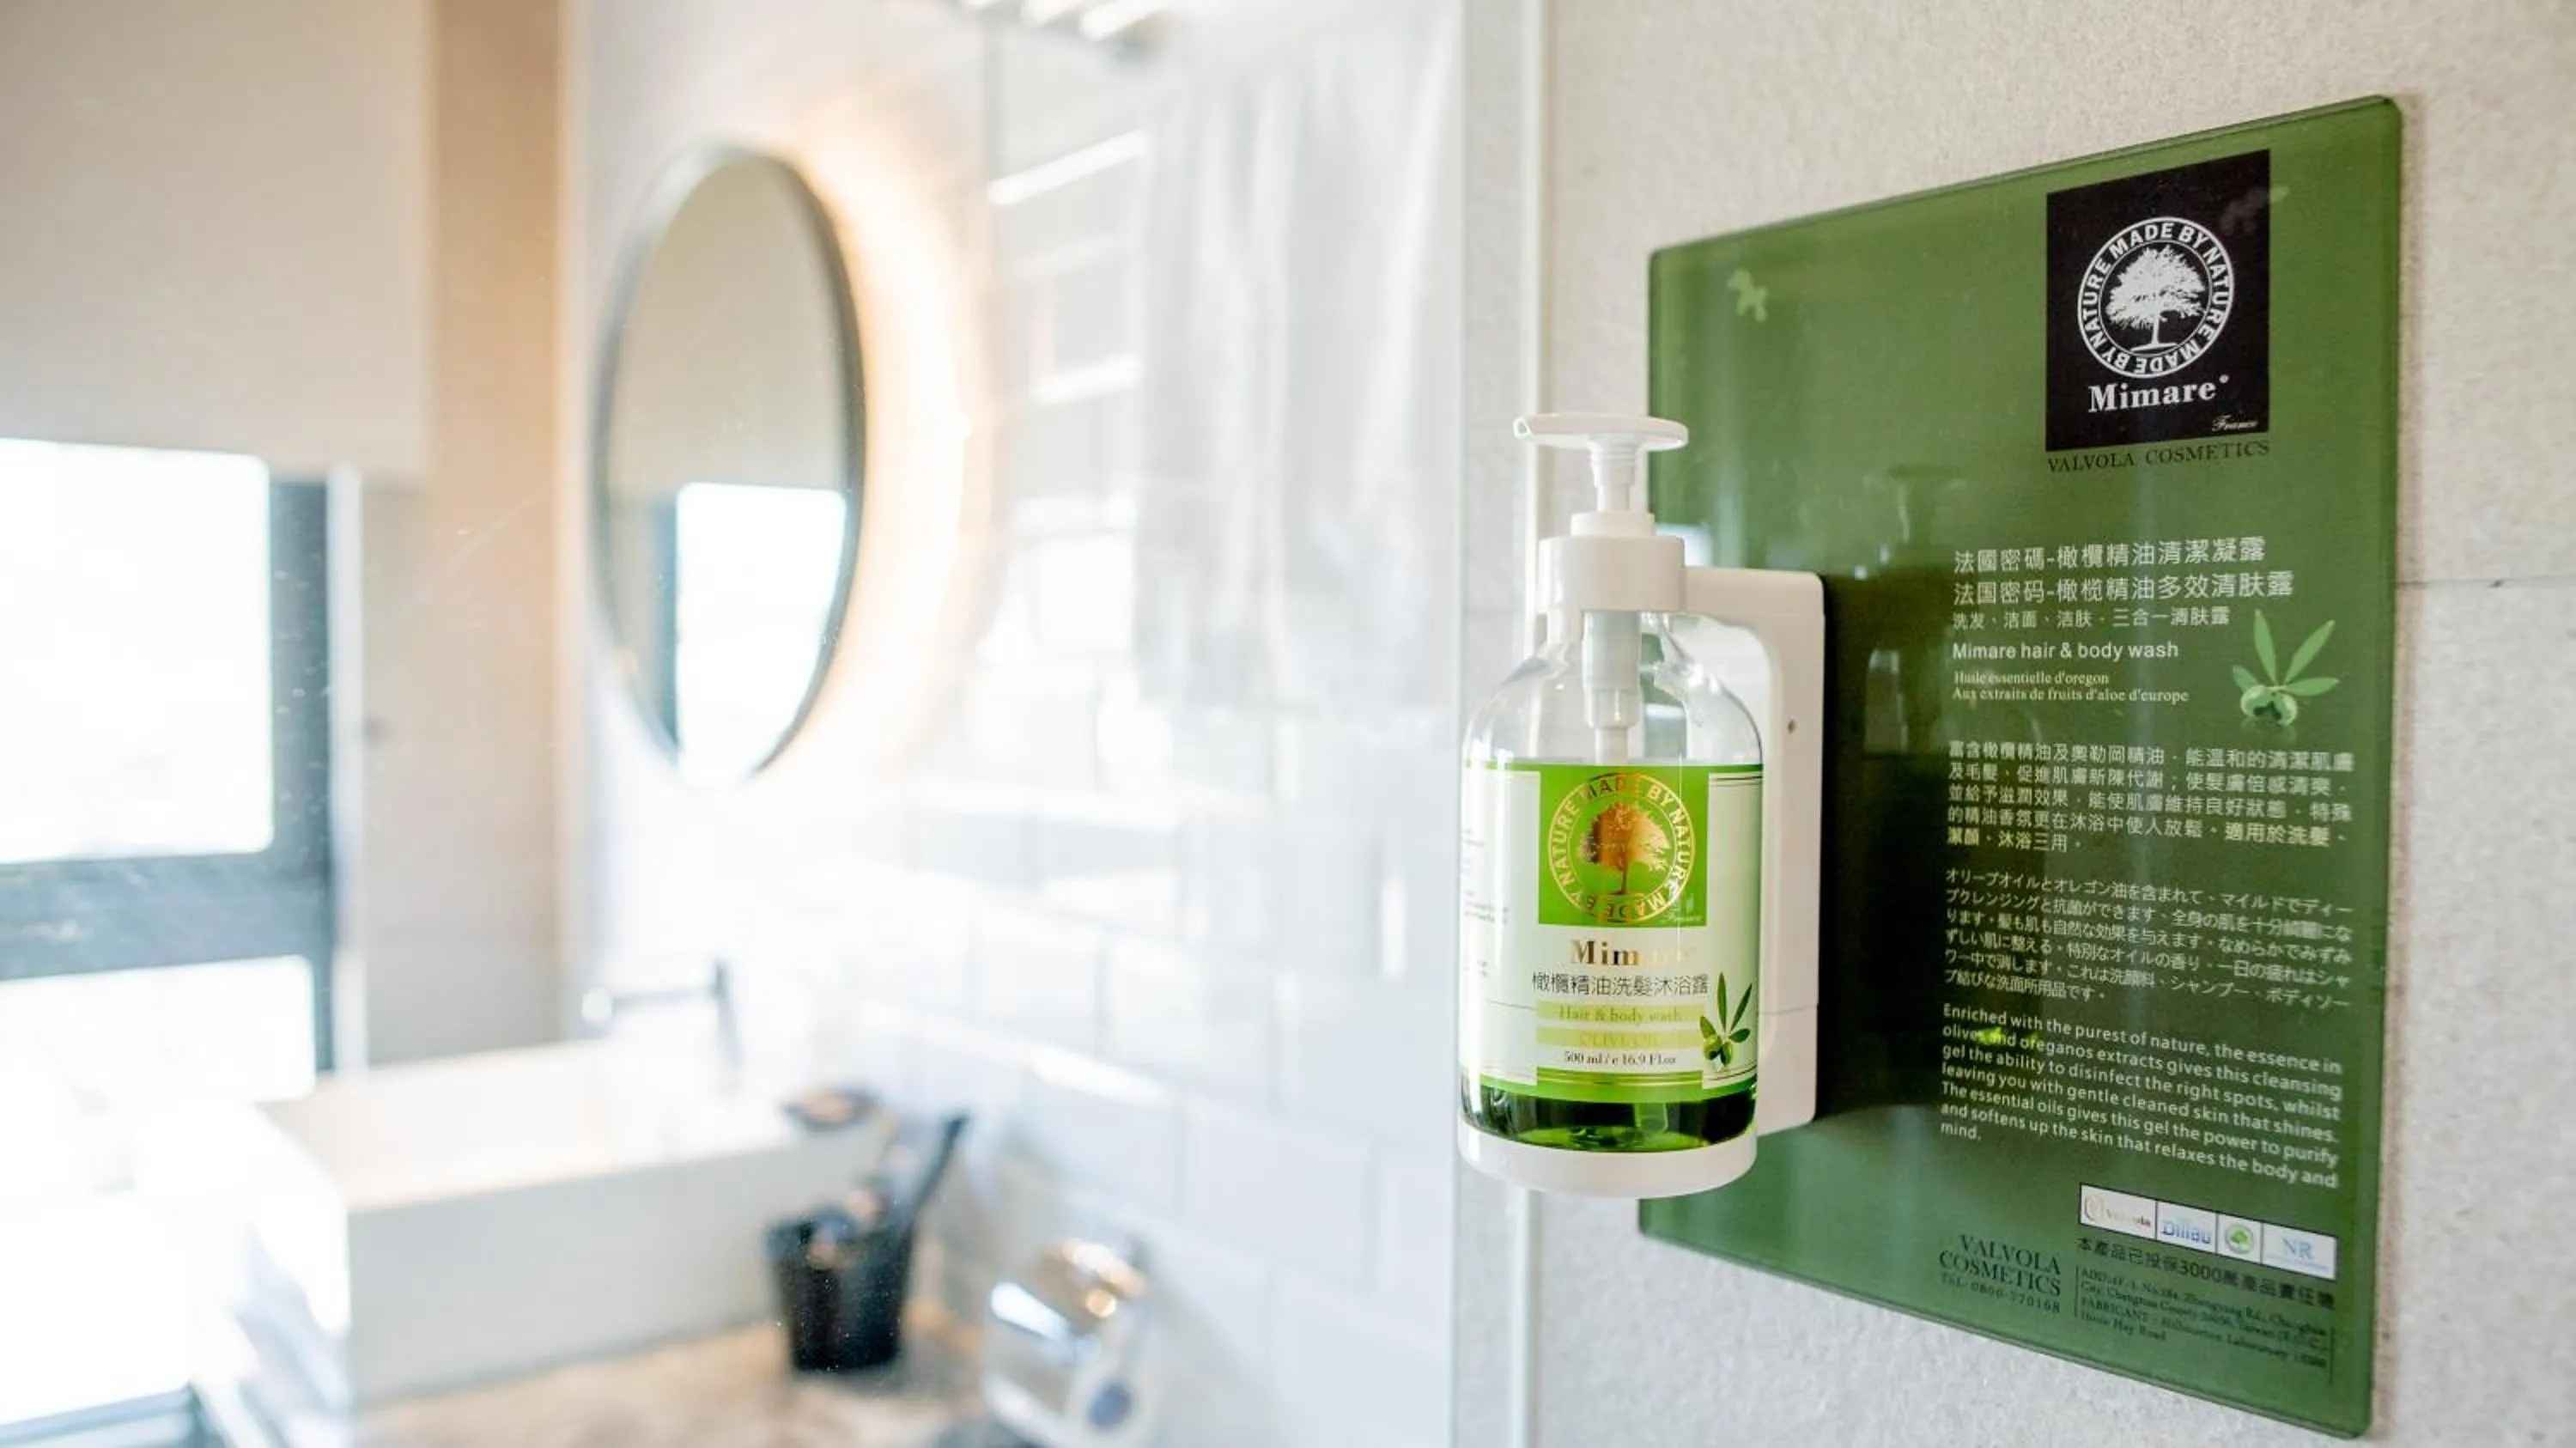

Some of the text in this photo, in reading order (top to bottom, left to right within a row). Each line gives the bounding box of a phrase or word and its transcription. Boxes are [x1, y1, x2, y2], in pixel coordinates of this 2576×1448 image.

[2082, 222, 2230, 374] MADE BY NATURE MADE BY NATURE
[2087, 381, 2218, 413] Mimare
[2047, 438, 2270, 473] VALVOLA COSMETICS
[1953, 536, 2267, 575] 法國密碼-橄欖精油清潔凝露
[1953, 569, 2295, 606] 法国密码-橄榄精油多效清肤露
[1953, 641, 2179, 663] Mimare hair & body wash
[1979, 687, 2027, 701] extraits
[2029, 687, 2044, 701] de
[2048, 686, 2083, 701] fruits
[2086, 686, 2126, 702] d'aloe
[2129, 689, 2190, 703] d'europe
[1646, 783, 1675, 809] BY
[1552, 799, 1582, 887] NATURE
[1610, 1007, 1644, 1025] body
[1564, 1050, 1584, 1063] 500
[1943, 1003, 2342, 1074] Enriched with the purest of nature, the essence in
[1942, 1044, 2342, 1121] gel the ability to disinfect the right spots, whilst
[2020, 1036, 2093, 1059] oreganos
[2097, 1049, 2163, 1070] extracts
[2166, 1058, 2212, 1077] gives
[2216, 1065, 2250, 1084] this
[2252, 1072, 2342, 1102] cleansing
[1942, 1062, 2340, 1143] leaving you with gentle cleaned skin that shines.
[1941, 1080, 2339, 1170] The essential oils gives this gel the power to purify
[1941, 1120, 1982, 1141] mind.
[1941, 1102, 2339, 1189] and softens up the skin that relaxes the body and
[1939, 1250, 2062, 1296] COSMETICS
[1960, 1233, 2061, 1275] VALVOLA
